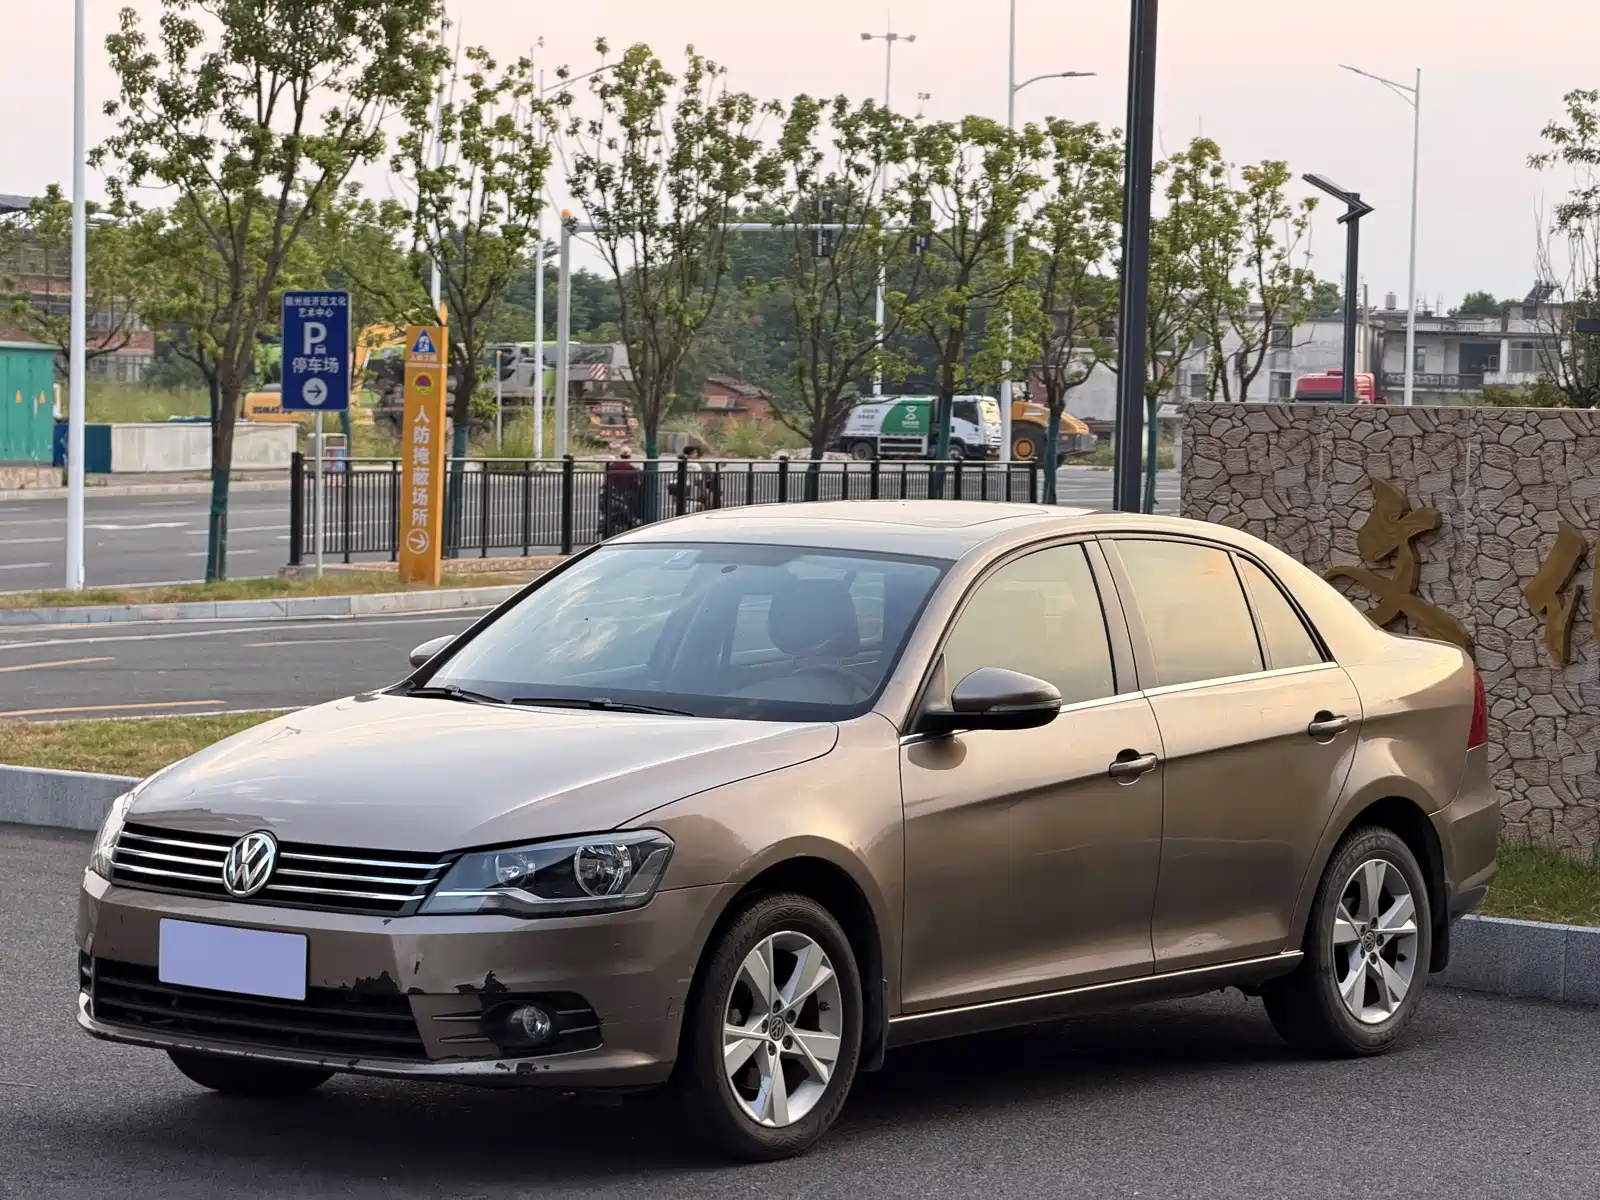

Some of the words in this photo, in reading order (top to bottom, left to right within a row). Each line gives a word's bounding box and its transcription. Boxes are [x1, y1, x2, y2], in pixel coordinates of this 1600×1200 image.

[303, 321, 328, 355] P
[292, 356, 340, 375] 停车场
[411, 404, 431, 527] 人防掩蔽场所
